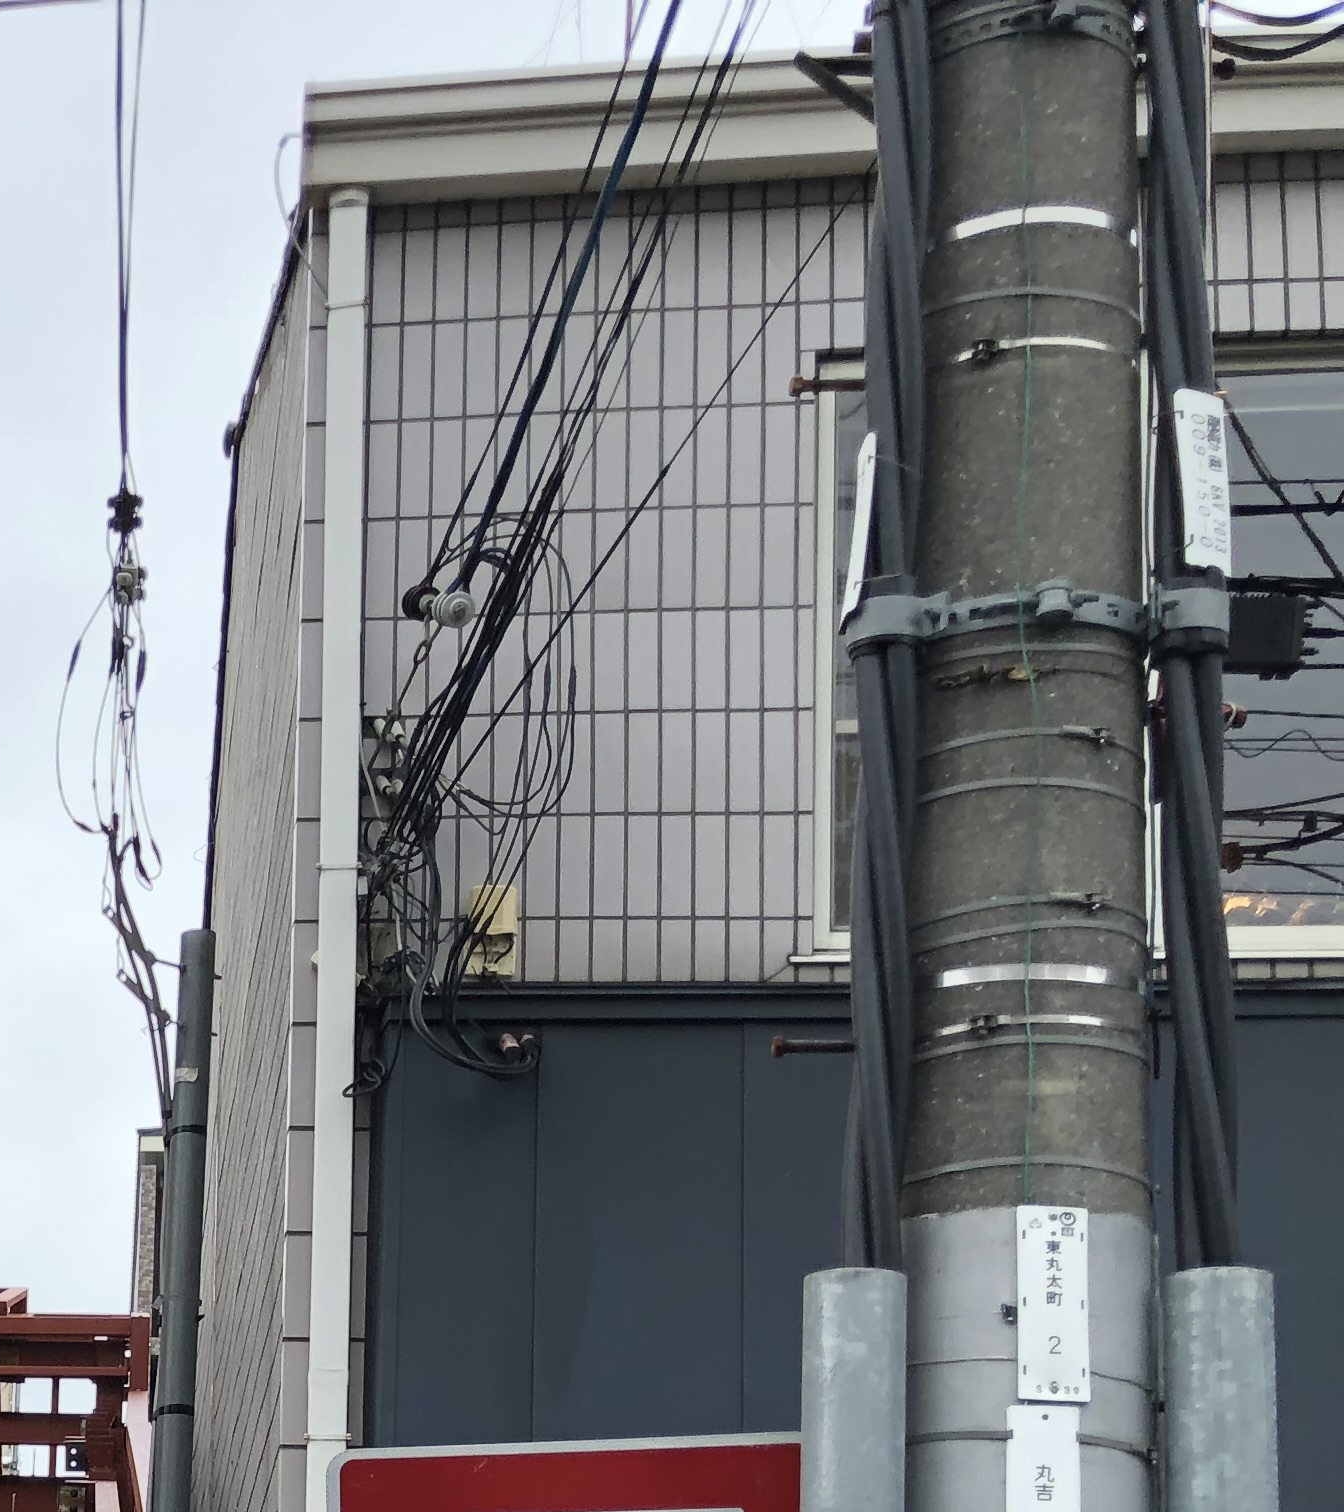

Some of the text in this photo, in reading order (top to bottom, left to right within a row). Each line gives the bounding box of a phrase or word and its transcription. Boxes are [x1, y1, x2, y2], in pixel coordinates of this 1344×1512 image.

[1045, 1240, 1063, 1307] 東丸太町
[1048, 1336, 1062, 1354] 2
[1035, 1464, 1055, 1501] 丸吉
